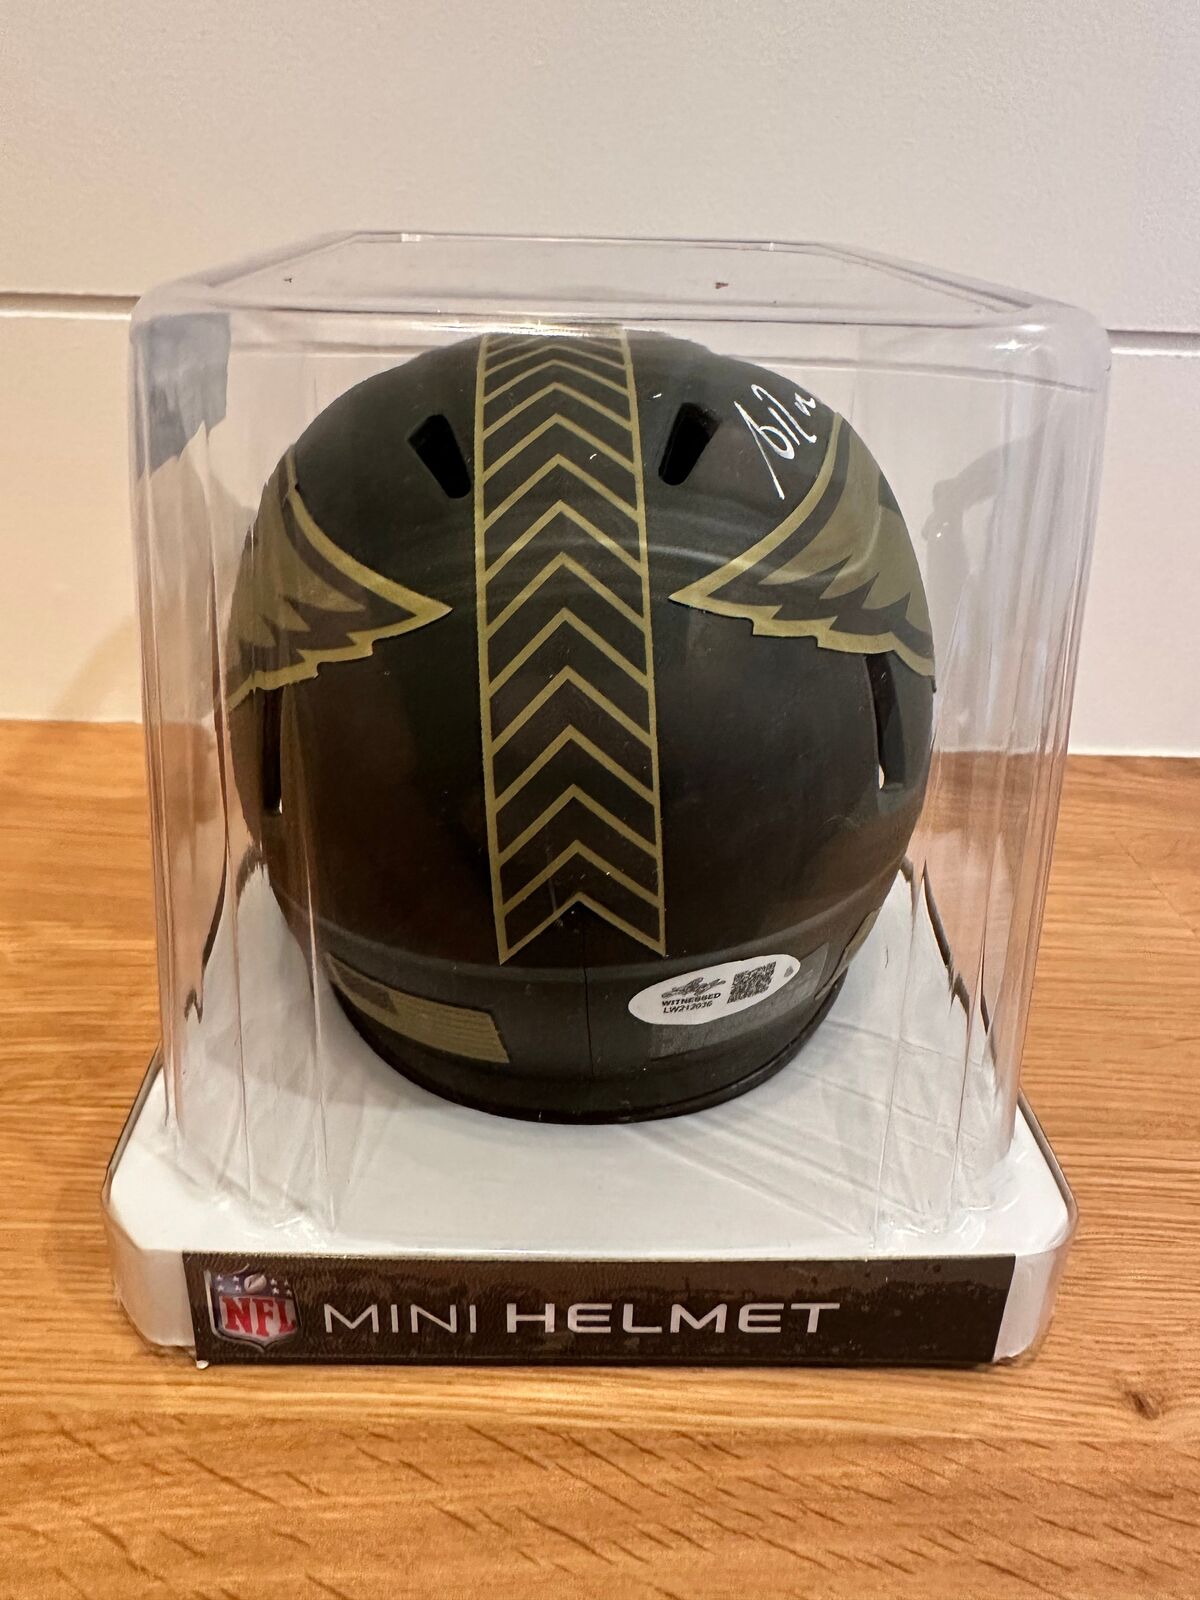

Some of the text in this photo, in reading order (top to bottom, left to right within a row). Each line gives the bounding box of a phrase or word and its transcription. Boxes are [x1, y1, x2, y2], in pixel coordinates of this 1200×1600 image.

[662, 992, 721, 1007] WITNESSED
[221, 1296, 297, 1337] NFL
[323, 1302, 841, 1334] MINI HELMET
